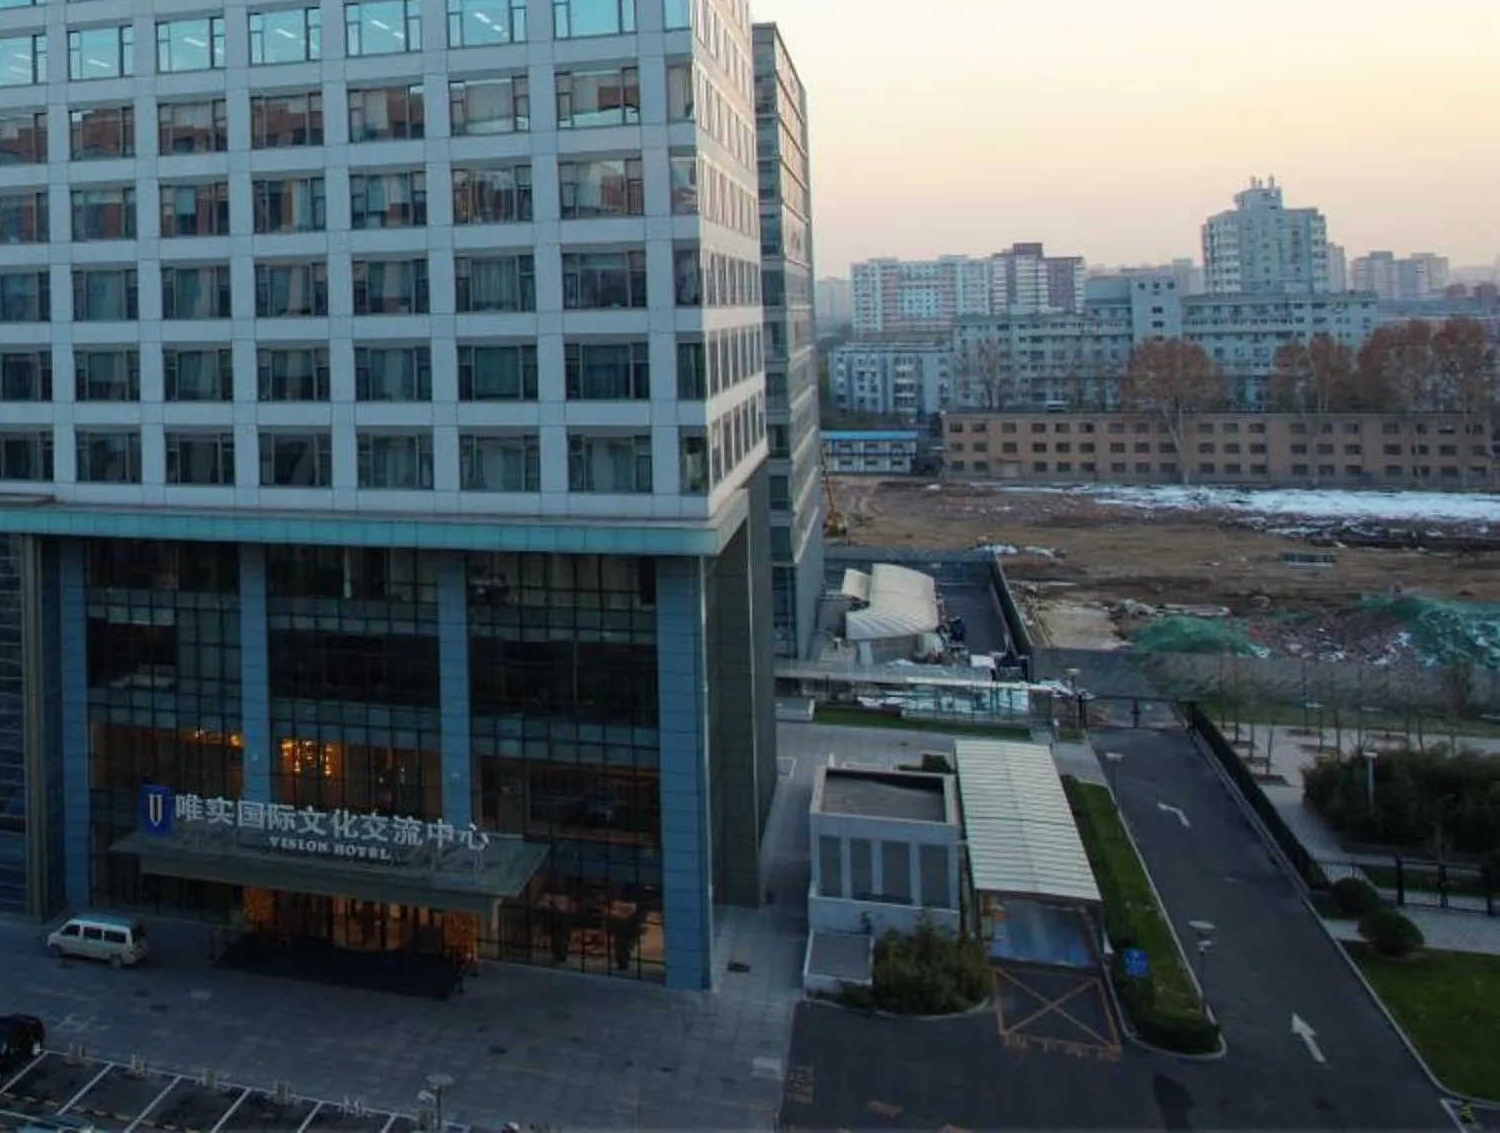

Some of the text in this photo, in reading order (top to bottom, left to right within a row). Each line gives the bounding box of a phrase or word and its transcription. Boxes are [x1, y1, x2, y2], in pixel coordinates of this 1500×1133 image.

[175, 793, 490, 852] 唯实国际文化交流中心
[269, 835, 392, 861] VISION HOTEL
